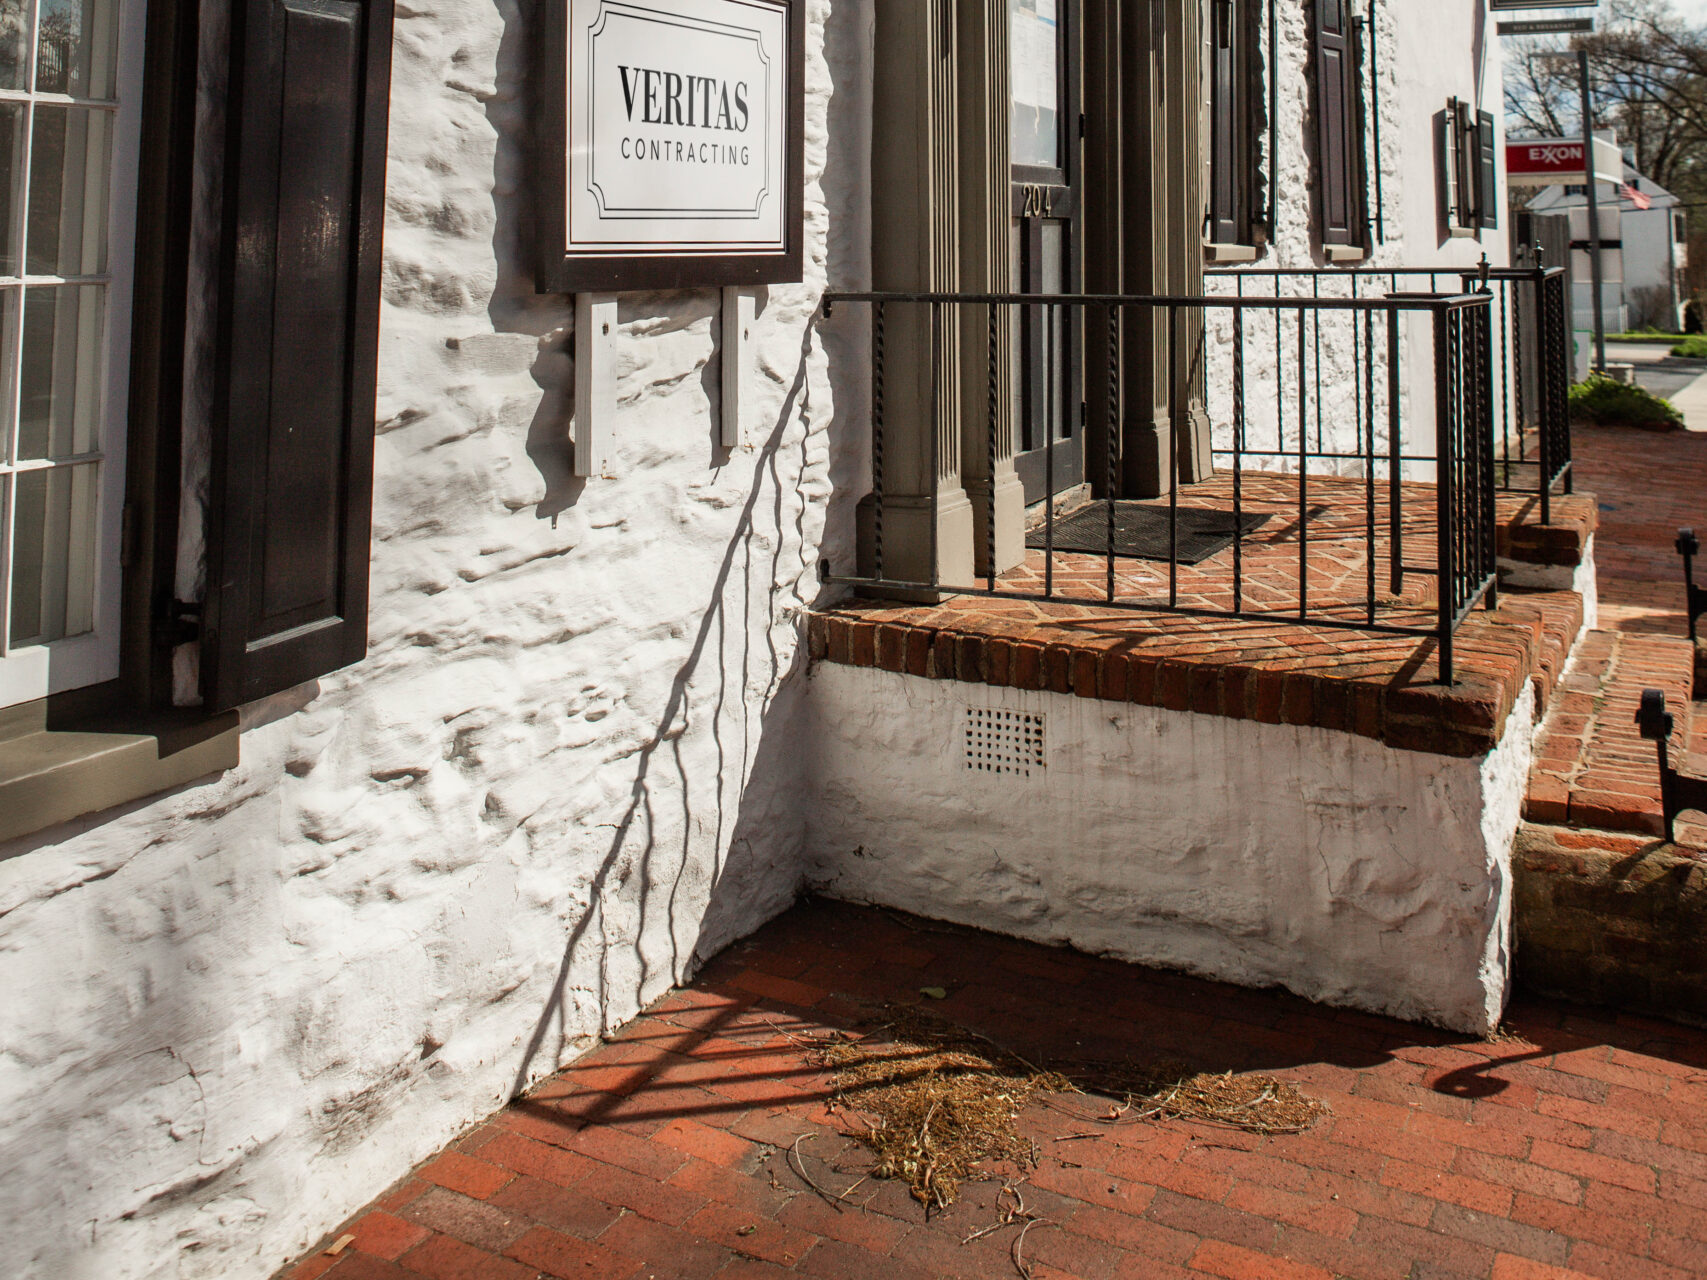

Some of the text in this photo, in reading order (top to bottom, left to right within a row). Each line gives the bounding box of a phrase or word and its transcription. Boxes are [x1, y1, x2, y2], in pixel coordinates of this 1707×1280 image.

[618, 65, 749, 132] VERITAS
[621, 137, 750, 166] CONTRACTING
[1529, 146, 1583, 164] EXXON
[1023, 183, 1052, 217] 204
